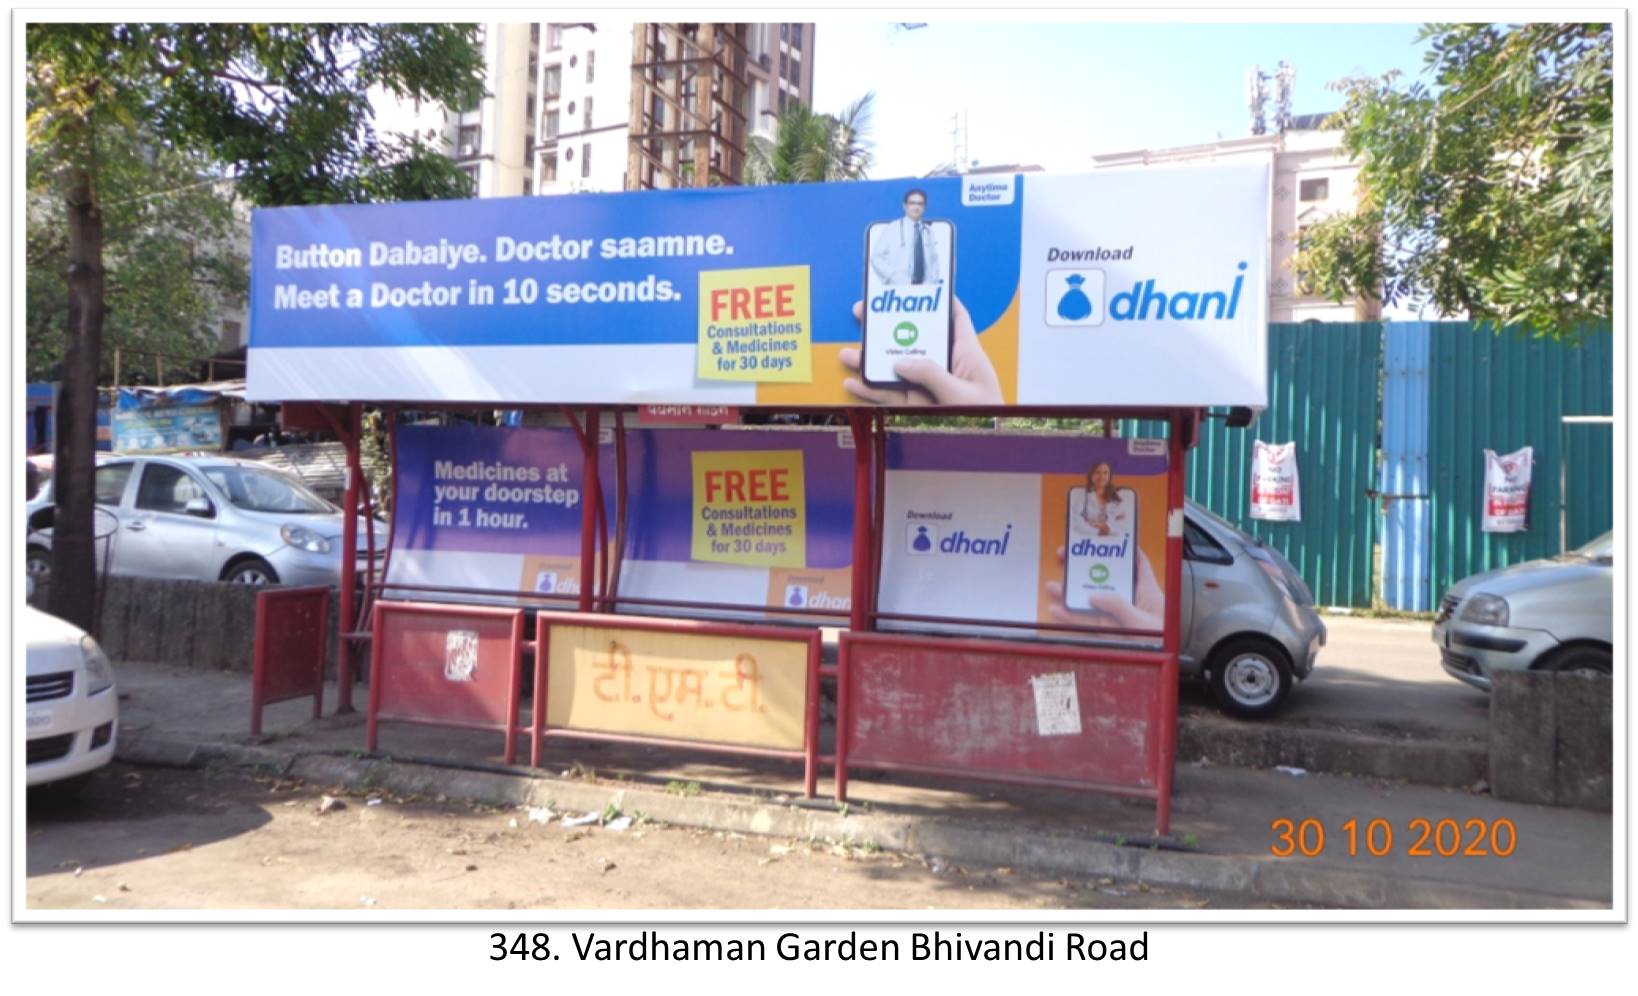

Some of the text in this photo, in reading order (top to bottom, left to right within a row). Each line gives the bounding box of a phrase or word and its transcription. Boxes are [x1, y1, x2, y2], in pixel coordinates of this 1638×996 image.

[275, 233, 735, 270] Button Dabaiye. Doctor saamne.
[1046, 245, 1134, 264] Download
[274, 274, 682, 310] Meet a Doctor in 10 seconds.
[710, 283, 796, 321] FREE
[870, 279, 945, 314] dhani
[1109, 261, 1249, 322] dhani
[706, 321, 802, 340] Consultations
[711, 337, 798, 355] & Medicines
[716, 353, 793, 371] for 30 days
[434, 460, 568, 483] Medicines at
[433, 482, 579, 508] your doorstep
[705, 468, 790, 503] FREE
[433, 507, 529, 529] in 1 hour.
[701, 505, 798, 522] Consultations
[706, 522, 793, 538] & Medicines
[940, 524, 1013, 556] dhani
[711, 538, 787, 556] for 30 days
[1071, 533, 1130, 558] dhani
[807, 591, 850, 610] dhan
